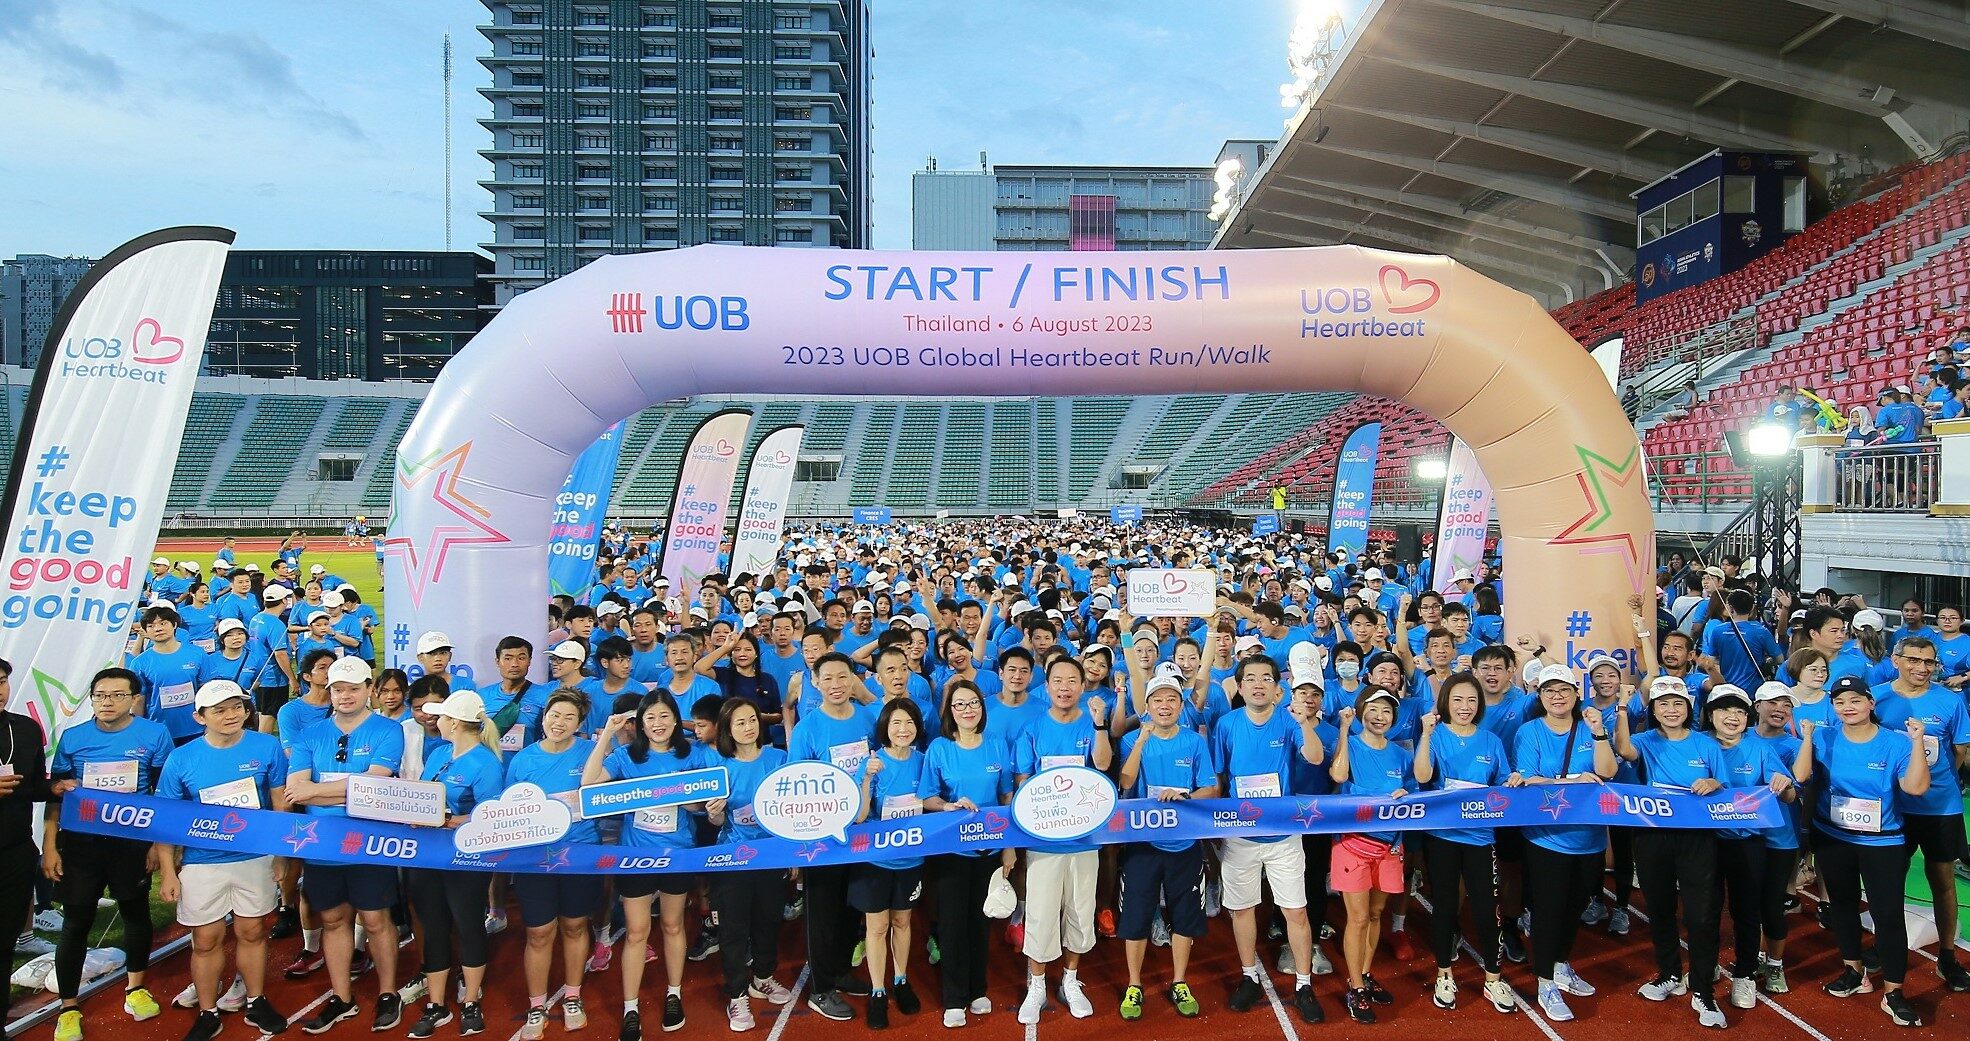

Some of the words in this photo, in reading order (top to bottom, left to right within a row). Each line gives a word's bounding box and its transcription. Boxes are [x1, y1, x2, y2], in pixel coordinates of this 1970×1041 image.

[824, 264, 993, 301] START
[1009, 263, 1032, 308] /
[1053, 265, 1230, 301] FINISH
[1301, 288, 1372, 314] UOB
[654, 295, 750, 331] UOB
[903, 315, 990, 332] Thailand
[1012, 317, 1023, 332] 6
[1029, 316, 1098, 337] August
[1104, 315, 1153, 332] 2023
[1301, 318, 1425, 338] Heartbeat
[65, 337, 121, 359] UOB
[782, 345, 845, 366] 2023
[854, 346, 910, 366] UOB
[919, 347, 1001, 367] Global
[1010, 348, 1140, 367] Heartbeat
[1149, 344, 1270, 368] Run/Walk
[62, 361, 168, 385] Heartbeat
[693, 445, 713, 454] UOB
[37, 445, 70, 478] #
[691, 453, 728, 464] Heartbeat
[756, 454, 774, 463] UOB
[755, 462, 786, 470] Heartbeat
[1339, 480, 1348, 489] #
[1451, 473, 1463, 485] #
[683, 484, 696, 496] #
[749, 486, 760, 496] #
[1337, 488, 1365, 502] keep
[1450, 488, 1483, 501] keep
[27, 483, 137, 528] keep
[680, 498, 717, 514] keep
[746, 497, 778, 512] keep
[1336, 500, 1355, 510] the
[1448, 502, 1470, 514] the
[677, 512, 704, 524] the
[745, 508, 766, 520] the
[1446, 511, 1483, 527] good
[743, 518, 776, 530] good
[1334, 517, 1367, 530] going
[19, 519, 94, 555] the
[674, 524, 716, 537] good
[740, 529, 778, 543] going
[1444, 525, 1485, 541] going
[547, 538, 595, 560] oing
[672, 537, 717, 553] going
[8, 556, 132, 591] good
[1133, 583, 1159, 594] UOB
[1133, 595, 1182, 603] Heartbeat
[2, 587, 134, 634] going
[1565, 611, 1592, 637] #
[393, 623, 410, 651] #
[167, 692, 190, 703] 2927
[94, 775, 126, 787] 1555
[775, 772, 835, 797] #ทำดี
[591, 779, 719, 806] #keepthegoodgoing
[1030, 786, 1052, 796] UOB
[1031, 792, 1070, 803] Heartbeat
[1245, 788, 1273, 798] 0007
[213, 793, 249, 807] 020
[1461, 801, 1485, 811] UOB
[1623, 794, 1674, 817] UOB
[482, 804, 541, 820] วิ่งคนเดียว
[891, 808, 915, 819] 0011
[1032, 802, 1068, 820] วิ่งเพื่อ
[1378, 803, 1426, 820] UOB
[1461, 810, 1504, 819] Heartbeat
[1707, 803, 1735, 813] UOB
[101, 803, 155, 828] UOB
[642, 812, 671, 825] 2959
[1130, 808, 1179, 830] UOB
[1213, 811, 1238, 820] UOB
[1710, 811, 1758, 821] Heartbeat
[1839, 811, 1871, 824] 1890
[192, 818, 220, 830] UOB
[959, 822, 984, 834] UOB
[1034, 815, 1090, 831] อนาคตน้อง
[1214, 818, 1256, 828] Heartbeat
[187, 829, 234, 842] Heartbeat
[874, 827, 923, 849] UOB
[960, 832, 1004, 842] Heartbeat
[365, 836, 418, 859] UOB
[452, 858, 498, 868] Heartbeat
[619, 856, 671, 869] UOB
[704, 859, 749, 867] Heartbeat
[707, 854, 732, 862] UOB
